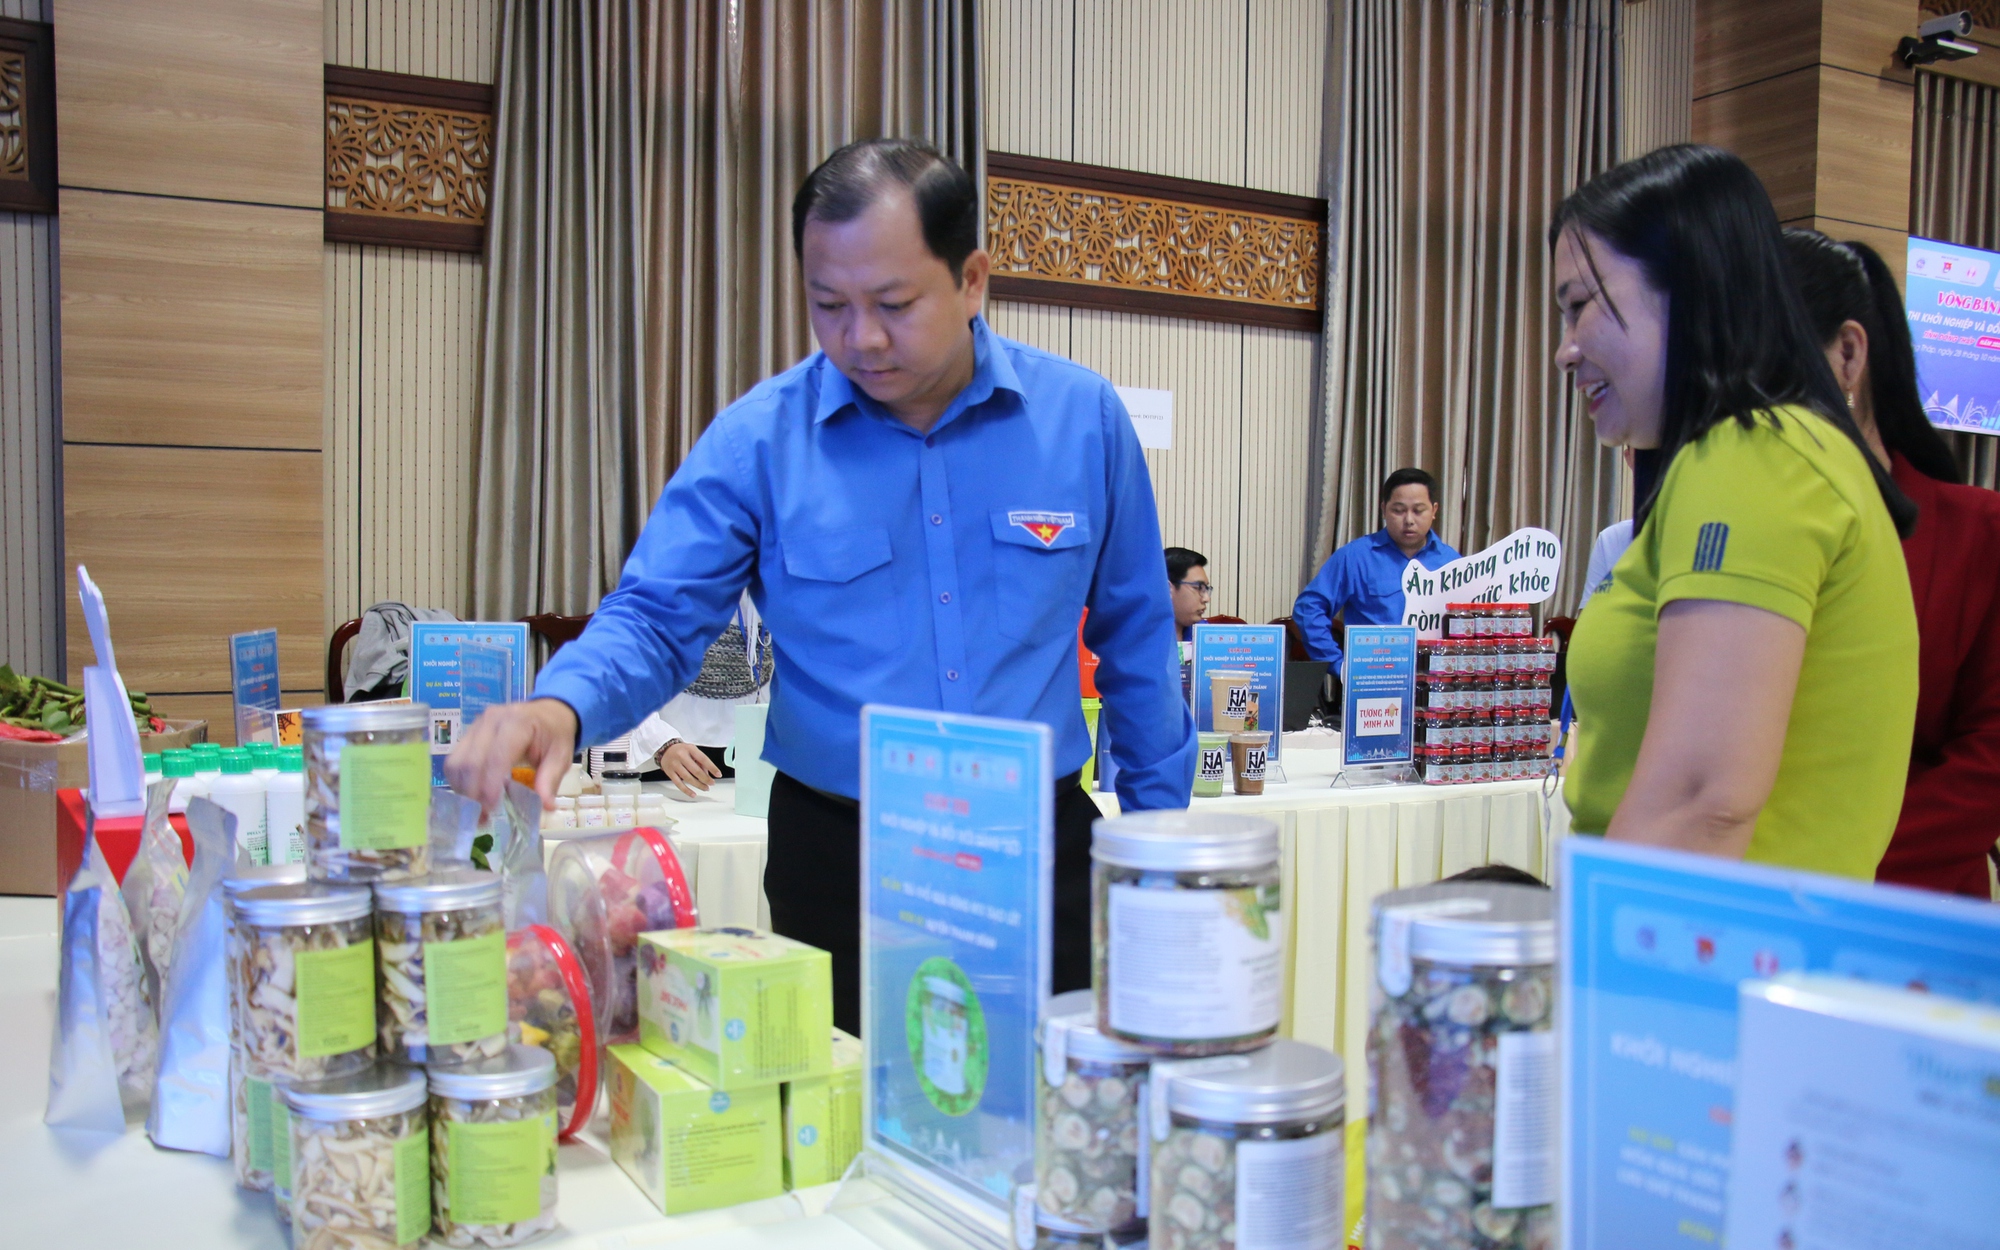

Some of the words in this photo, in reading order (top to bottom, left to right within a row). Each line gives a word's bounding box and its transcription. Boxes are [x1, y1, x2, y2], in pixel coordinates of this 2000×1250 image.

[1908, 311, 1920, 321] THI
[1921, 312, 1943, 325] KHỞI
[1943, 317, 1973, 331] NGHIỆP
[1974, 320, 1986, 332] VÀ
[1406, 566, 1434, 596] Ăn
[1440, 554, 1497, 593] không
[1503, 535, 1531, 565] chỉ
[1536, 540, 1556, 559] no
[1509, 568, 1550, 596] khỏe
[1360, 708, 1382, 718] TƯƠNG
[1364, 720, 1382, 729] MINH
[1384, 719, 1395, 728] AN
